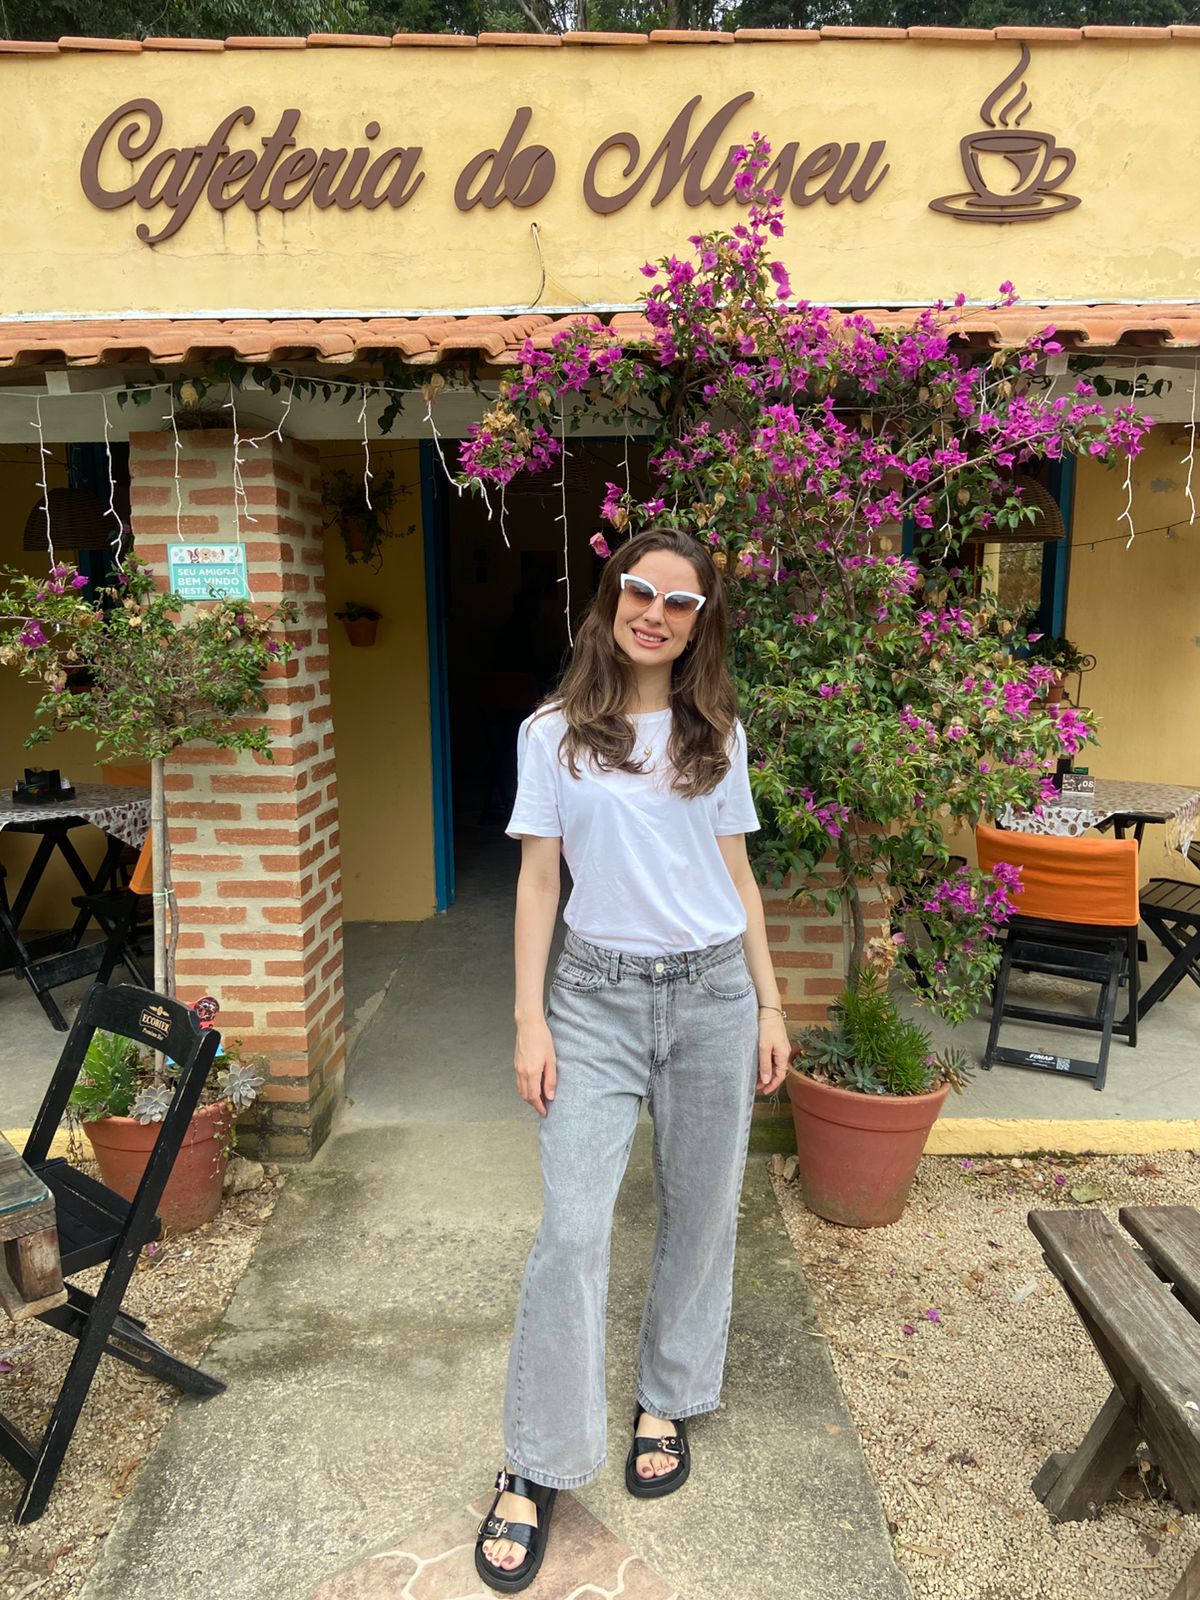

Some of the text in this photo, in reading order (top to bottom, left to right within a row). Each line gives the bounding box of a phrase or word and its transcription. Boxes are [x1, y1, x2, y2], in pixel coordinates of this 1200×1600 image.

[80, 91, 890, 246] Cafeteria do Museu
[177, 568, 196, 576] SEU
[198, 568, 230, 576] AMIGO
[177, 577, 240, 586] BEM VINDO
